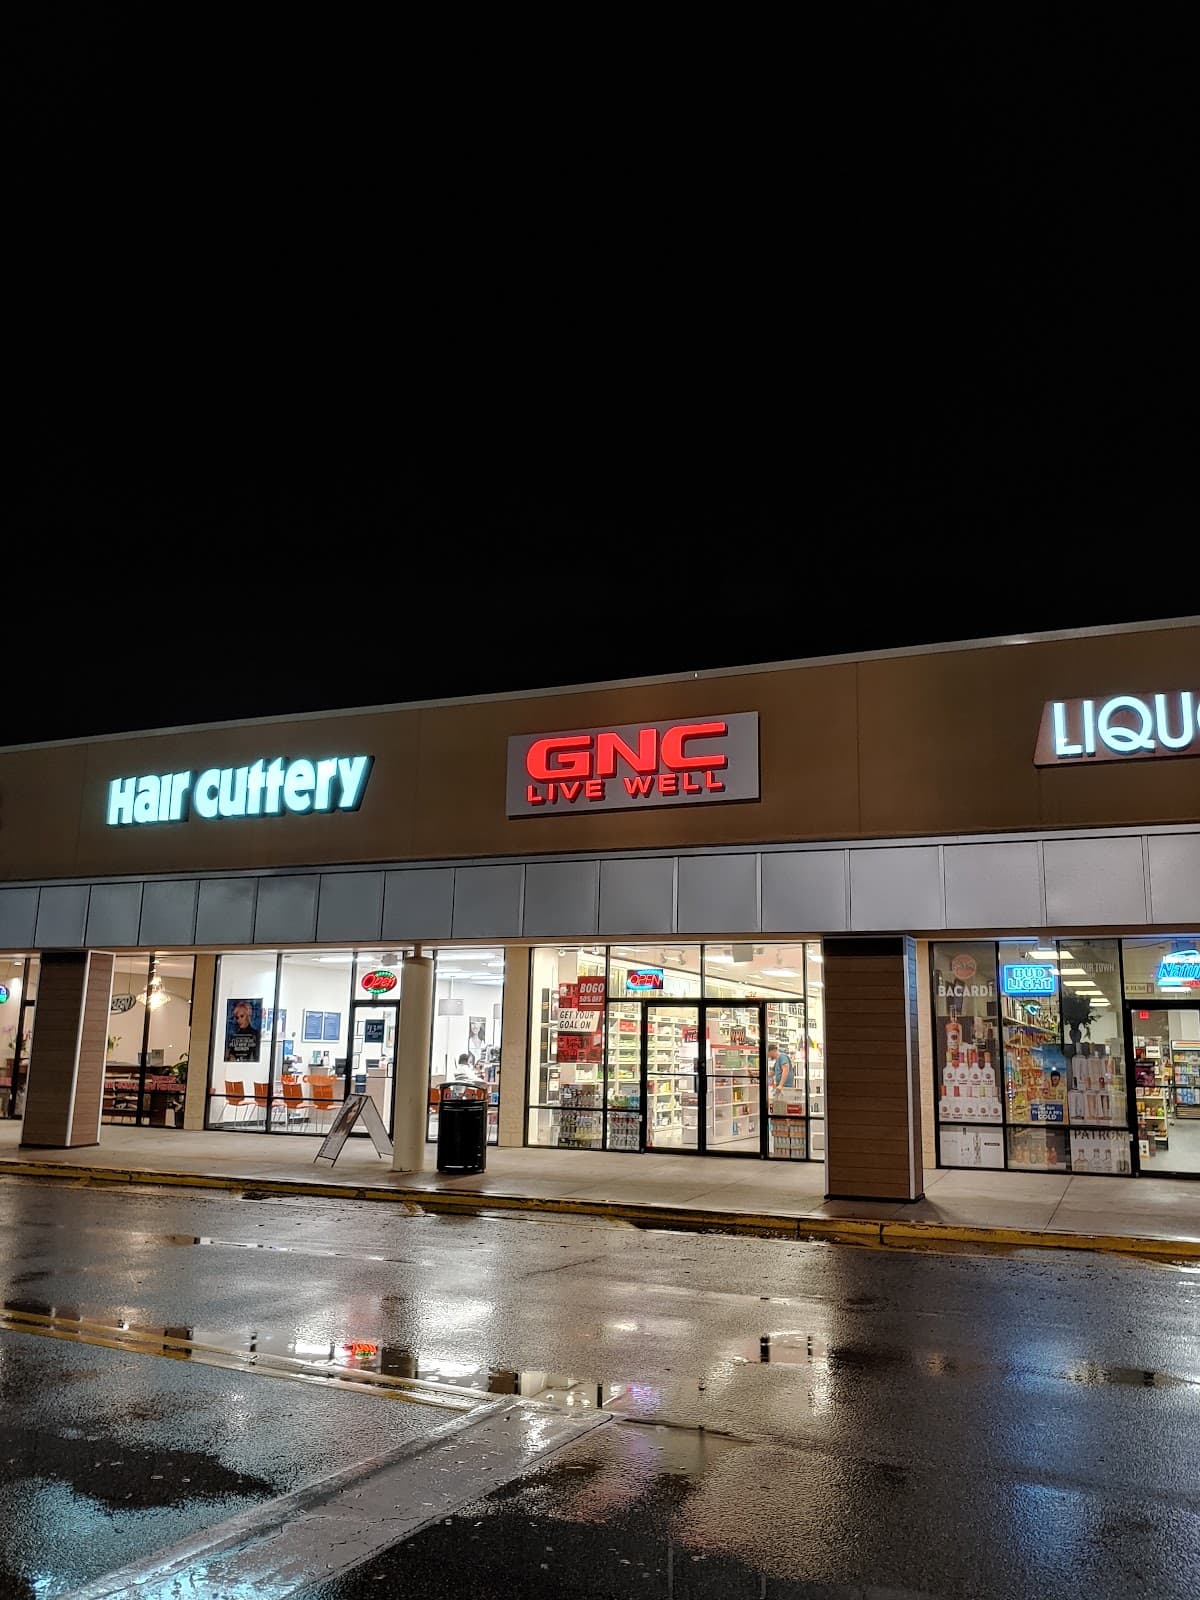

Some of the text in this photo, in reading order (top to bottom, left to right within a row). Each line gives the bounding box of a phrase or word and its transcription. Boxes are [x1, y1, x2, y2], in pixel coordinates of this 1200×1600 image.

[1053, 691, 1200, 756] LIQU
[526, 721, 727, 781] GNC
[526, 770, 724, 803] LIVE WELL
[106, 769, 191, 825] Hair
[1013, 967, 1045, 978] BUD
[629, 974, 661, 986] OPEN
[1008, 978, 1051, 990] LIGHT
[579, 982, 605, 993] BOGO
[559, 1010, 596, 1019] GET YOUR
[559, 1020, 592, 1029] GOAL ON
[1037, 1113, 1057, 1121] COLD
